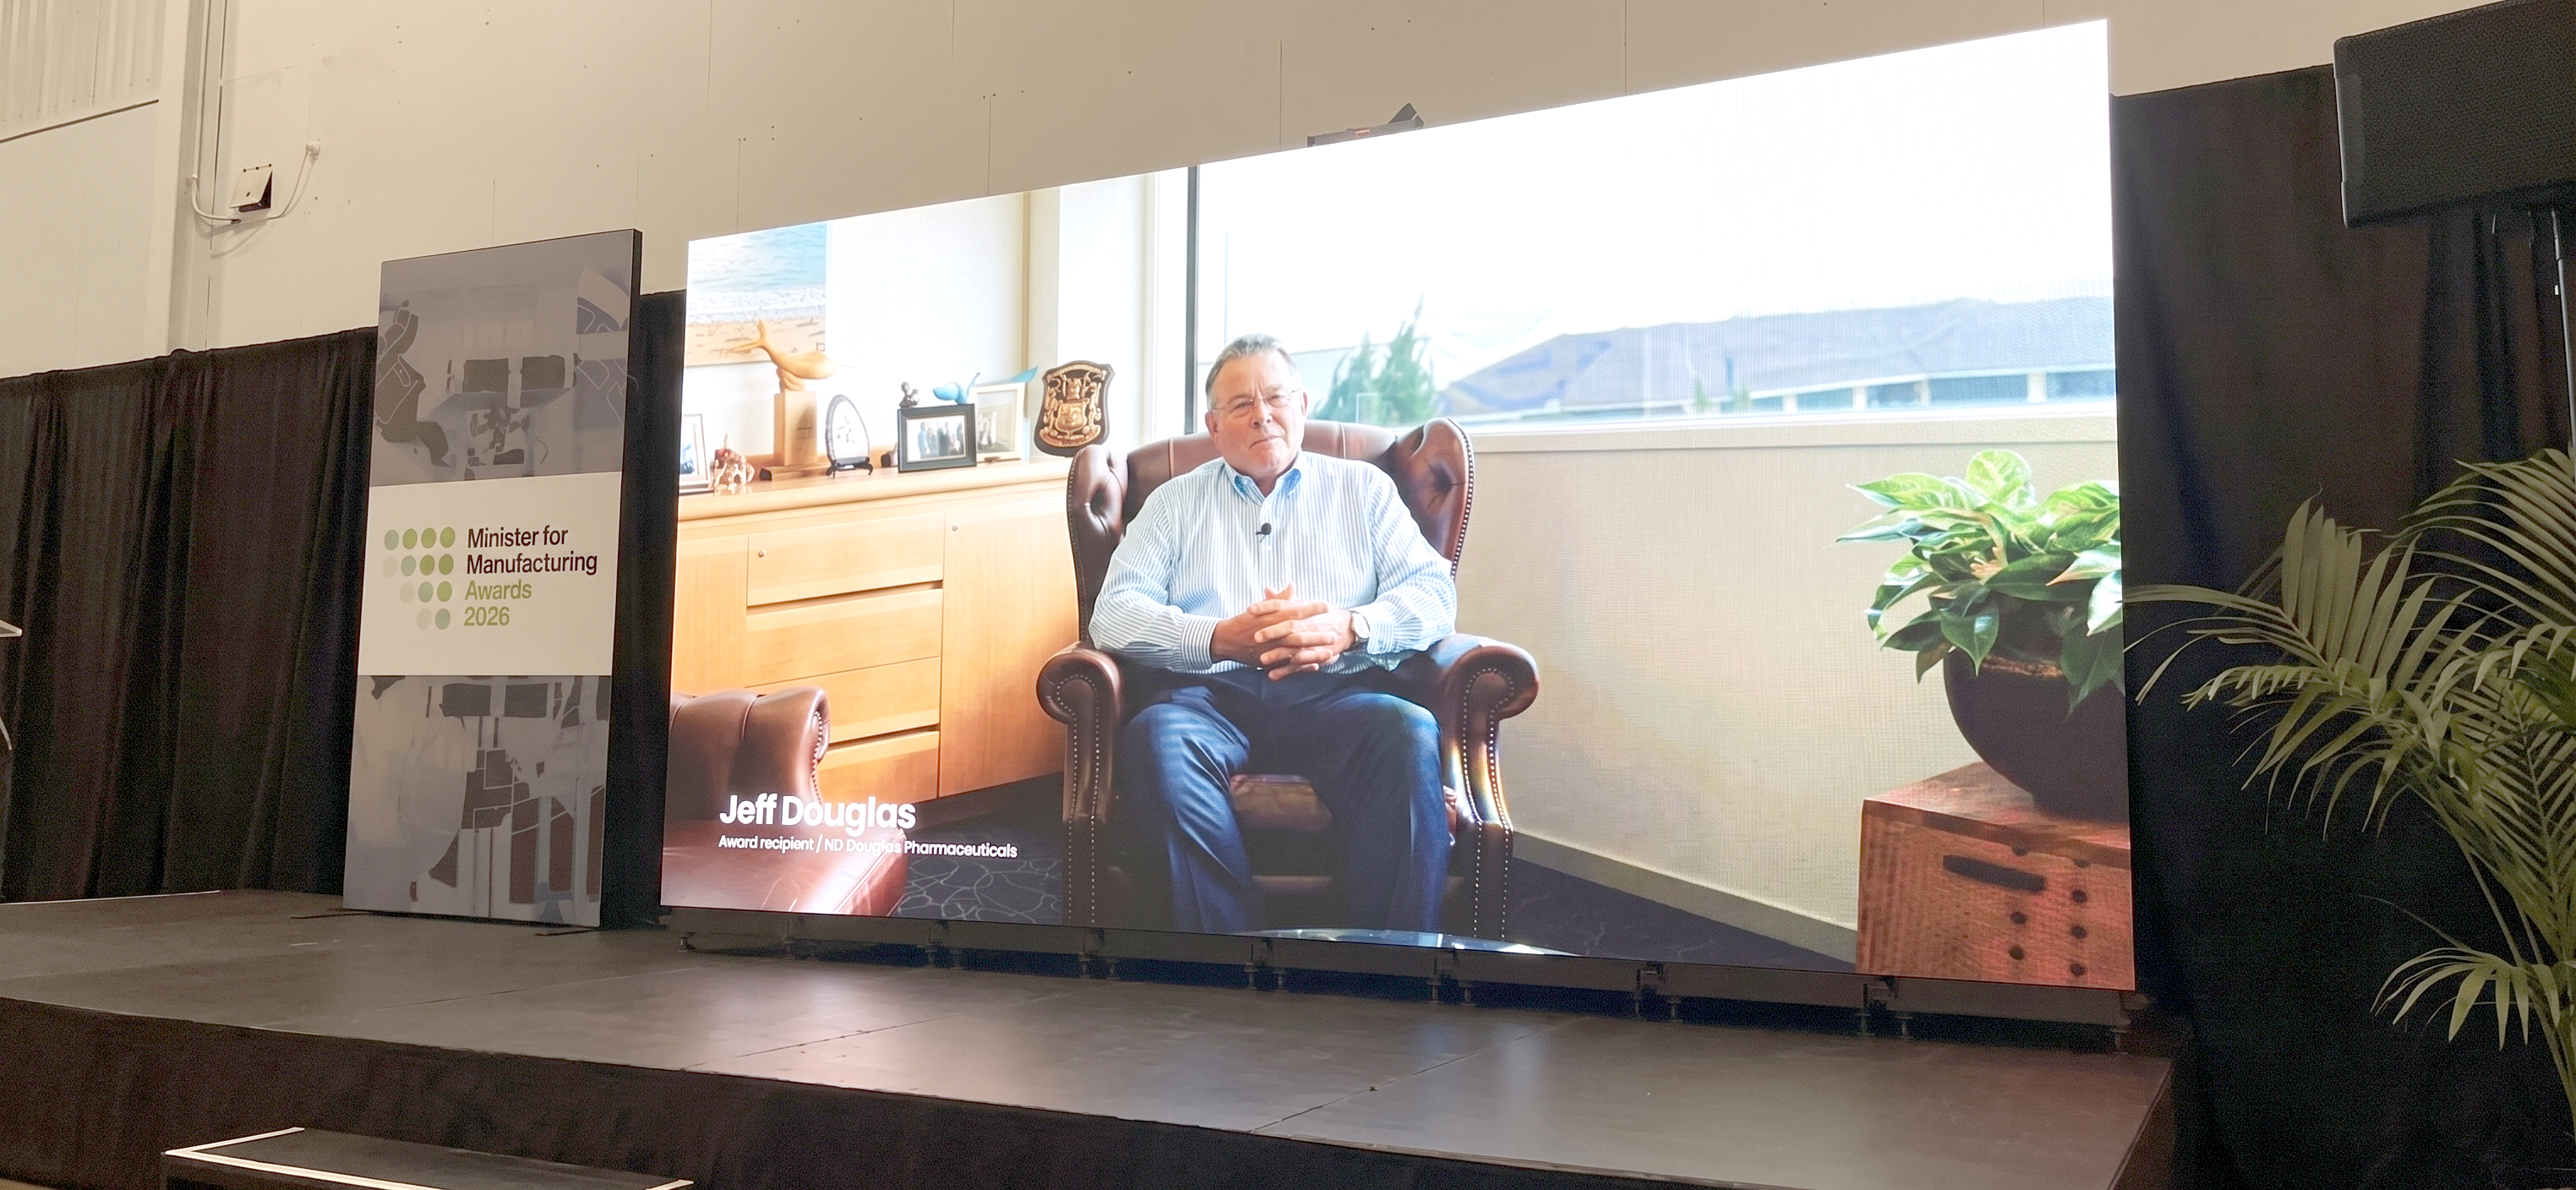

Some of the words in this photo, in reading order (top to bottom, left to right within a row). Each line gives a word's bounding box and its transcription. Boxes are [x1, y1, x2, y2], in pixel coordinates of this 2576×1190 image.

[467, 527, 539, 549] Minister
[543, 525, 569, 545] for
[467, 550, 598, 576] Manufacturing
[465, 579, 532, 600] Awards
[463, 606, 510, 626] 2026
[719, 793, 778, 825] Jeff
[782, 796, 916, 837] Douglas
[718, 835, 758, 849] Award
[760, 836, 814, 854] recipient
[824, 838, 843, 852] ND
[846, 839, 902, 857] Douglas
[903, 841, 1018, 859] Pharmaceuticals
